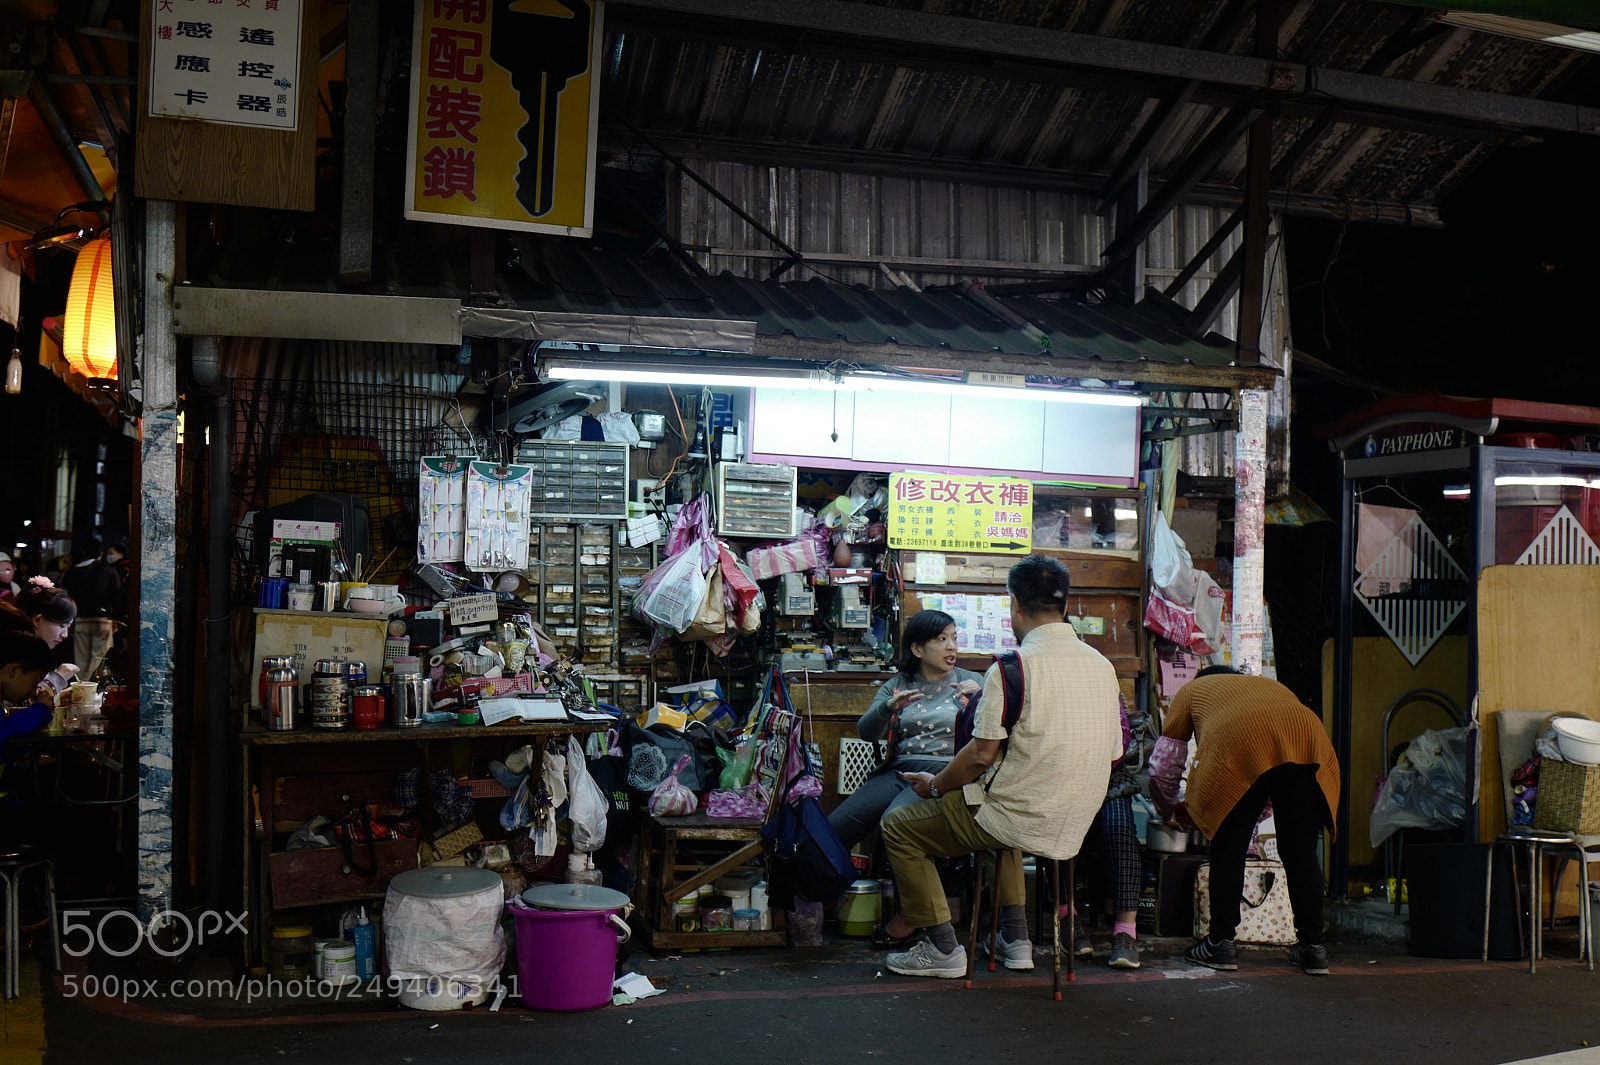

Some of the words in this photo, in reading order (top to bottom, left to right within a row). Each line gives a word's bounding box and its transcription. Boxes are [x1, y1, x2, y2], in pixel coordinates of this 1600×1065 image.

[174, 21, 213, 106] 感應卡
[236, 27, 275, 113] 遙控器
[1380, 430, 1454, 454] PAYPHONE
[895, 477, 1029, 506] 修改衣褲
[898, 505, 934, 514] 男女衣褲
[994, 511, 1022, 523] 請洽
[898, 527, 934, 536] 牛仔褲
[986, 526, 1029, 539] 吳媽媽
